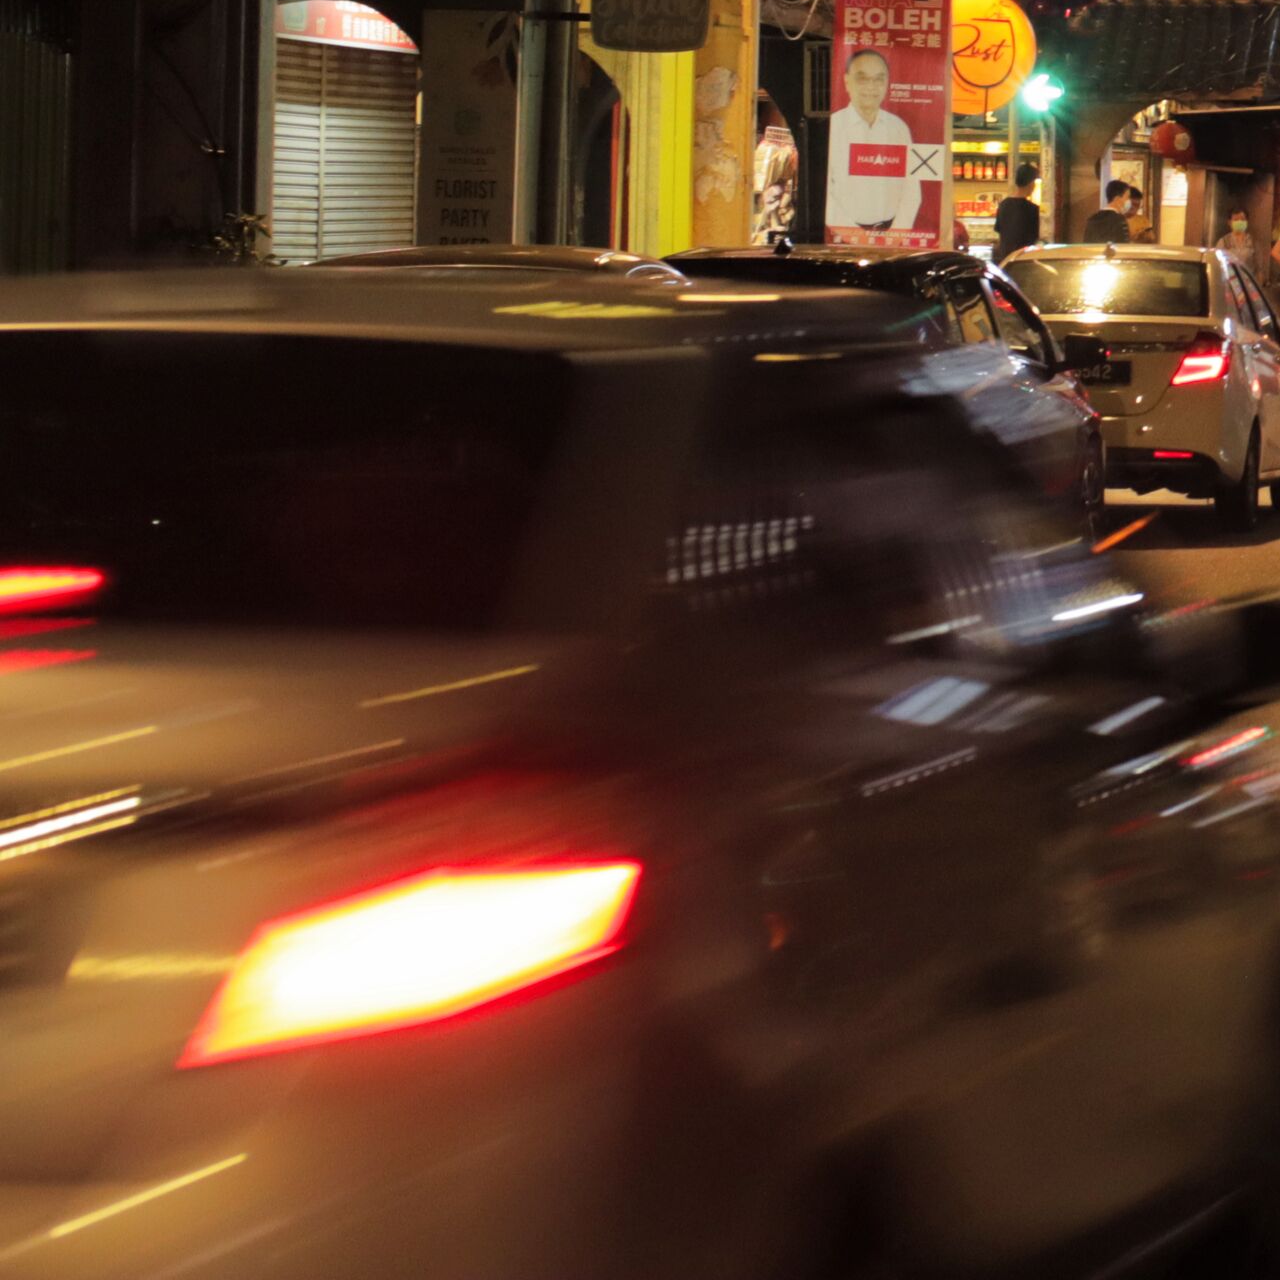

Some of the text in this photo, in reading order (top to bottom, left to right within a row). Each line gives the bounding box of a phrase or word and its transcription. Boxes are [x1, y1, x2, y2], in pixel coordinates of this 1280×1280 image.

[844, 7, 942, 31] BOLEH
[856, 153, 900, 166] HARAPAN
[435, 179, 498, 200] FLORIST
[440, 208, 491, 228] PARTY
